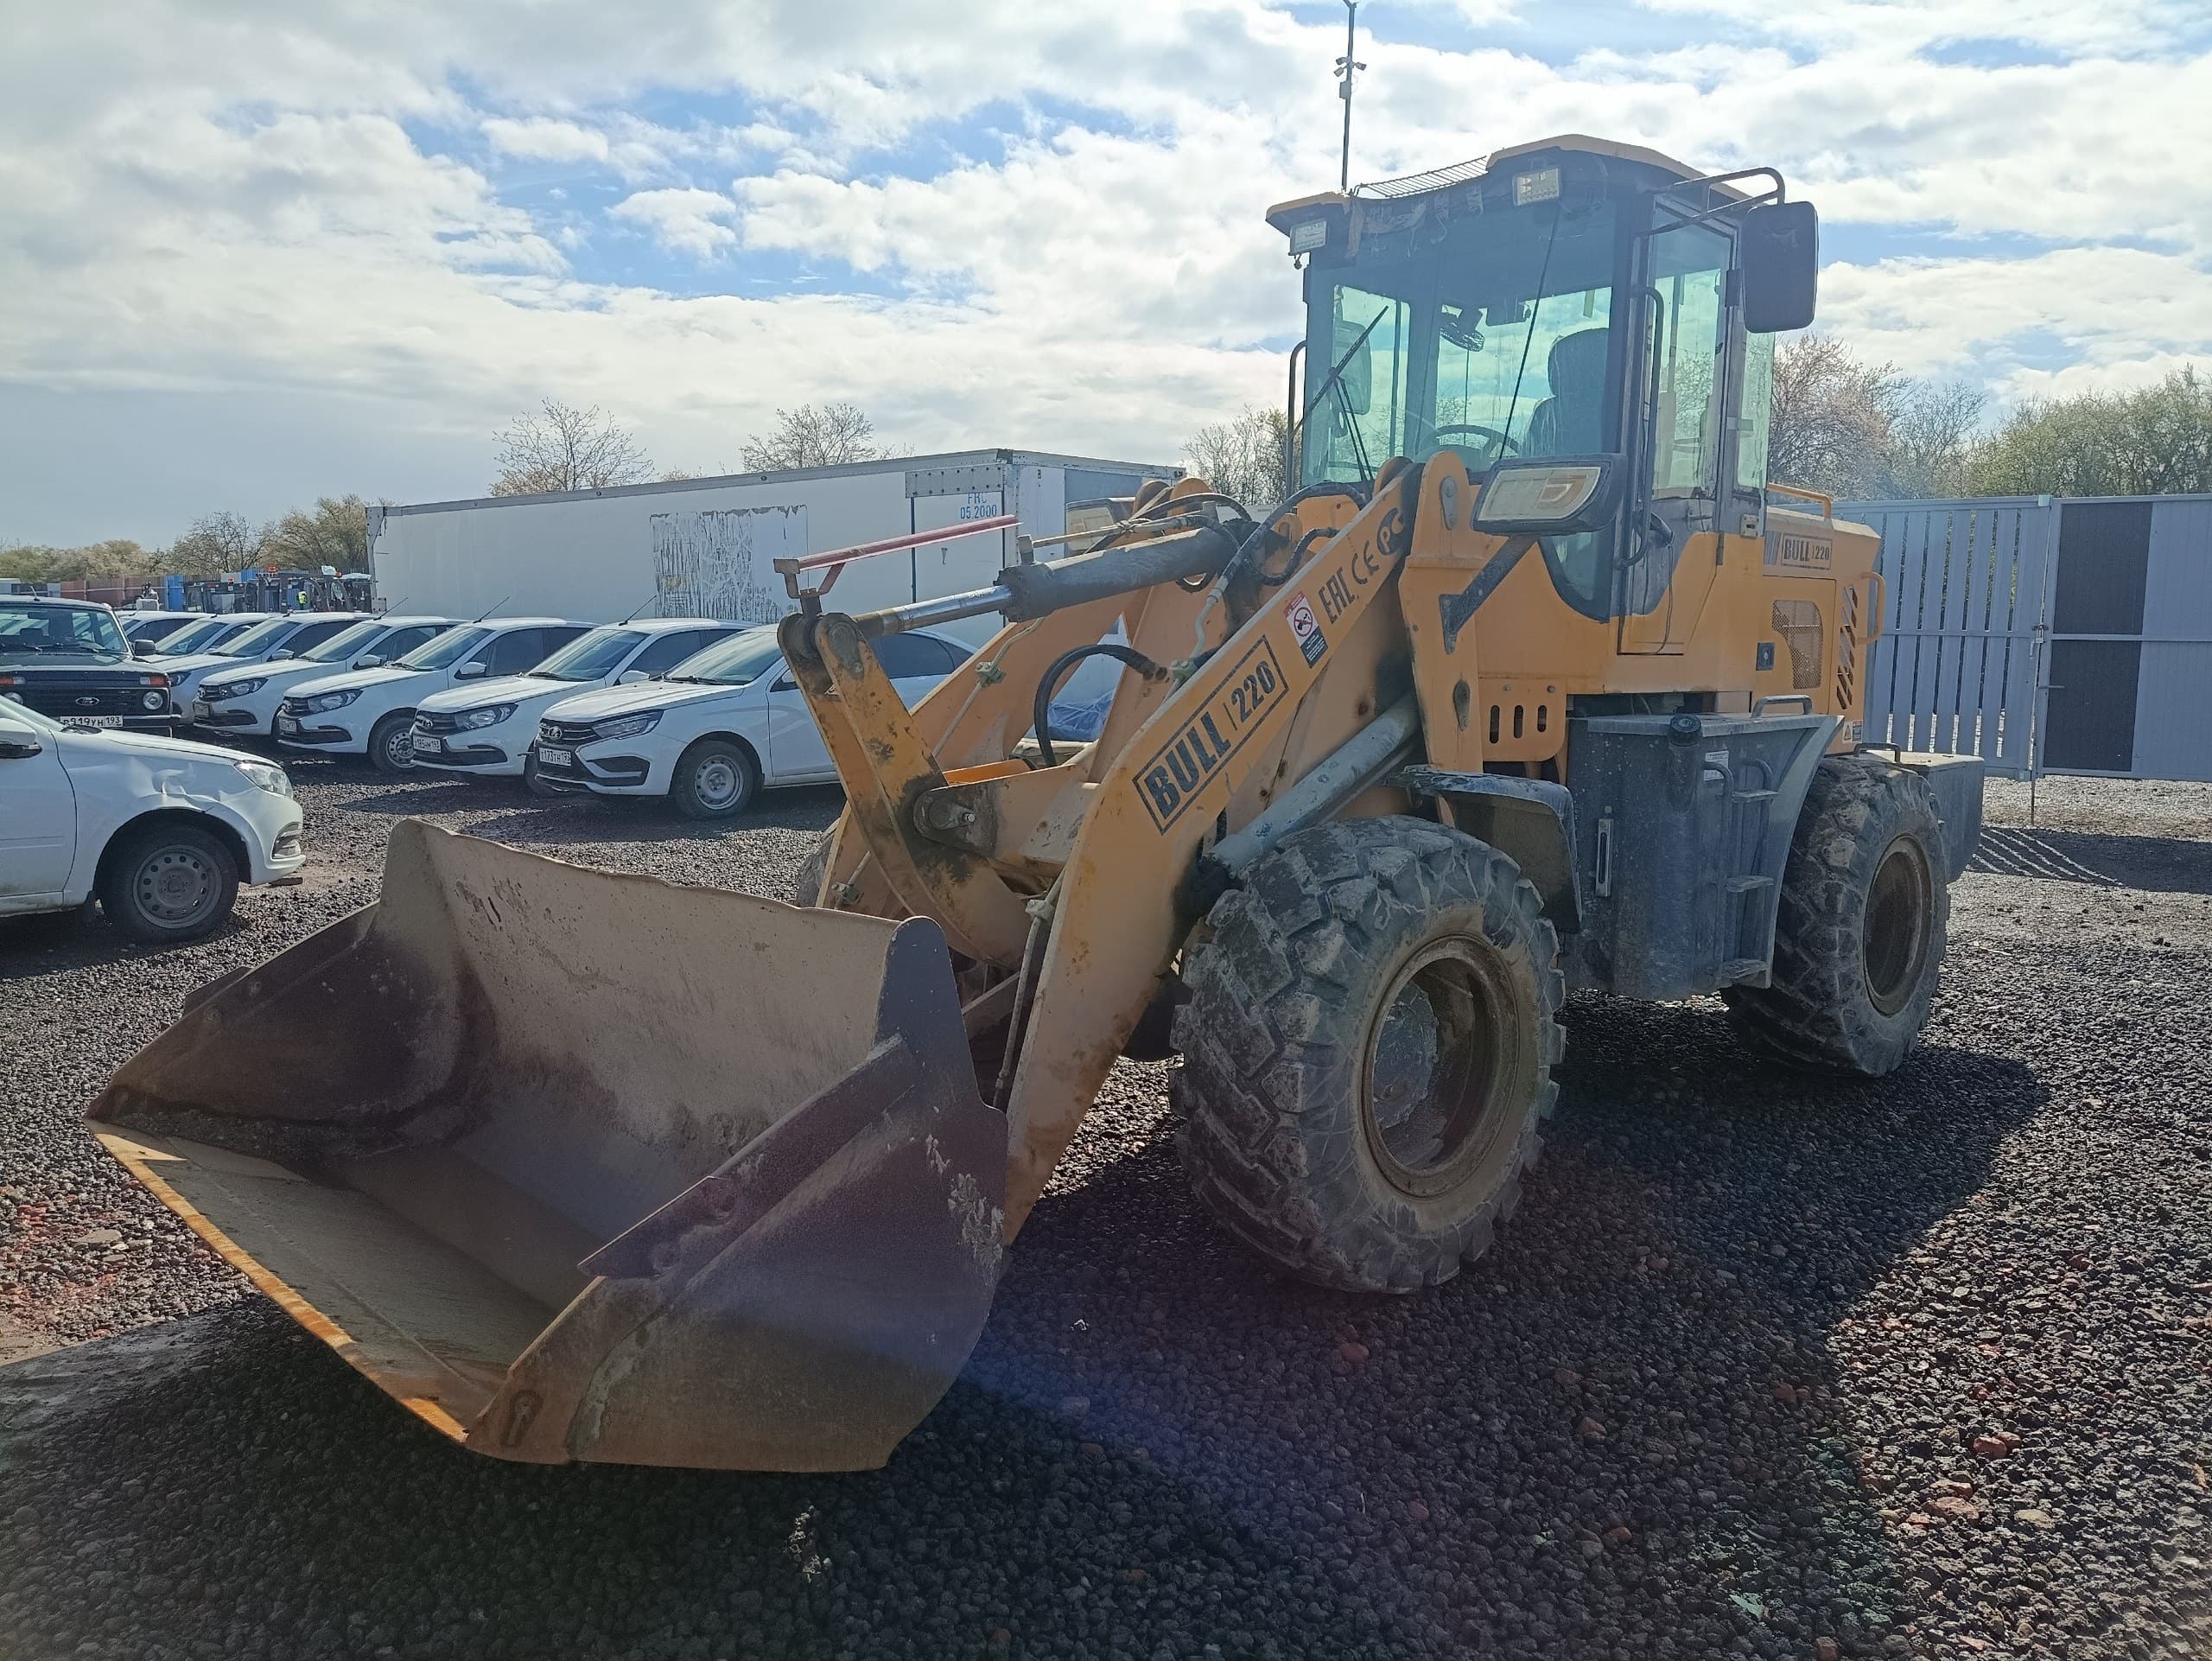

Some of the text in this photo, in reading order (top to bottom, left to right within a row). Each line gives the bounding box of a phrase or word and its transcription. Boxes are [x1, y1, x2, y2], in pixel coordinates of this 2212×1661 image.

[960, 504, 997, 519] 05.2000
[1783, 538, 1830, 562] BULL 220
[1143, 660, 1276, 819] BULL 220
